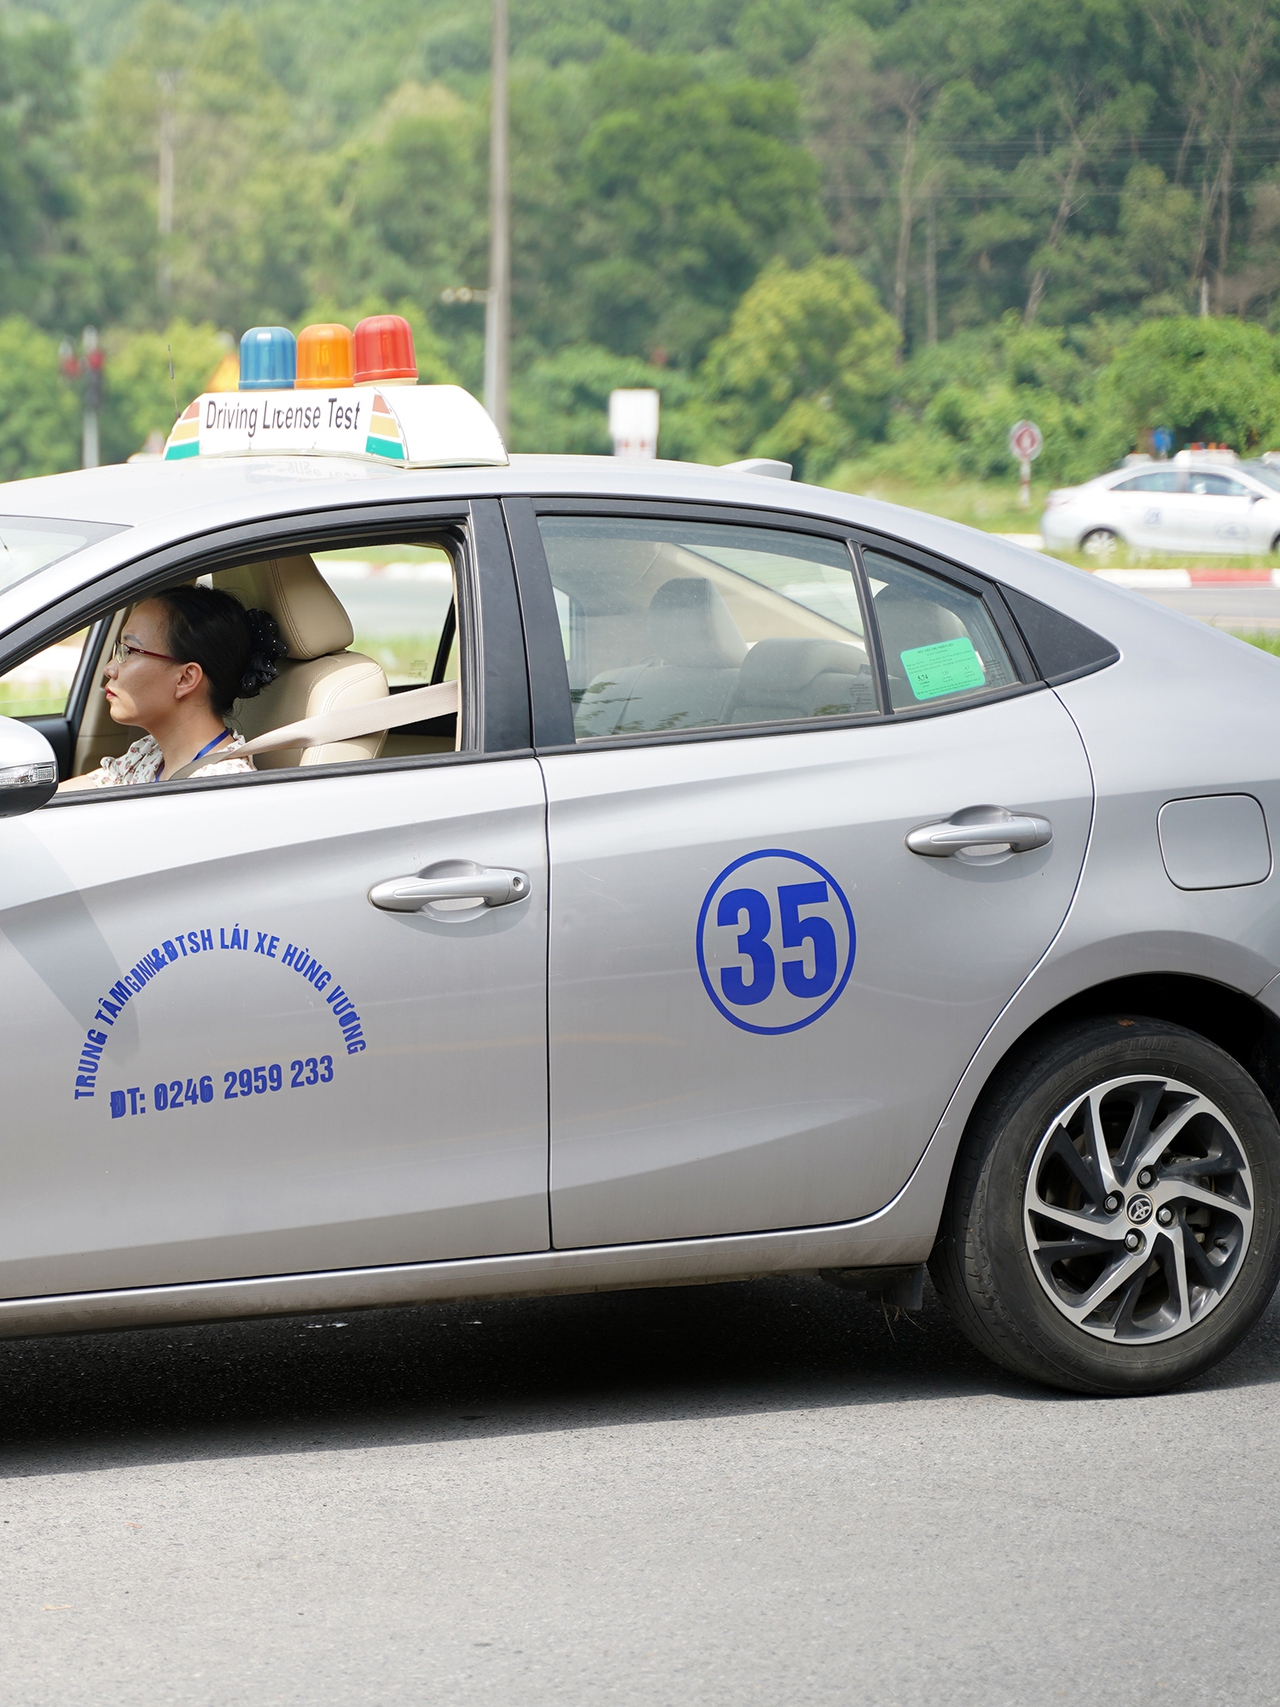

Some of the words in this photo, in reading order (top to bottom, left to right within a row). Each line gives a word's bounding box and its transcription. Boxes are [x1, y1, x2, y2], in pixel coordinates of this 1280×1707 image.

[206, 400, 258, 438] Driving
[262, 400, 321, 429] License
[328, 398, 361, 430] Test
[717, 880, 838, 1006] 35
[74, 1028, 108, 1100] TRUNG
[94, 980, 133, 1026] TÂM
[220, 923, 249, 950] LÁI
[253, 931, 280, 958] XE
[281, 943, 332, 992] HÙNG
[326, 985, 366, 1055] VƯƠNG
[110, 1086, 146, 1119] ĐT:
[154, 1075, 214, 1111] 0246
[224, 1064, 283, 1100] 2959
[290, 1055, 334, 1088] 233
